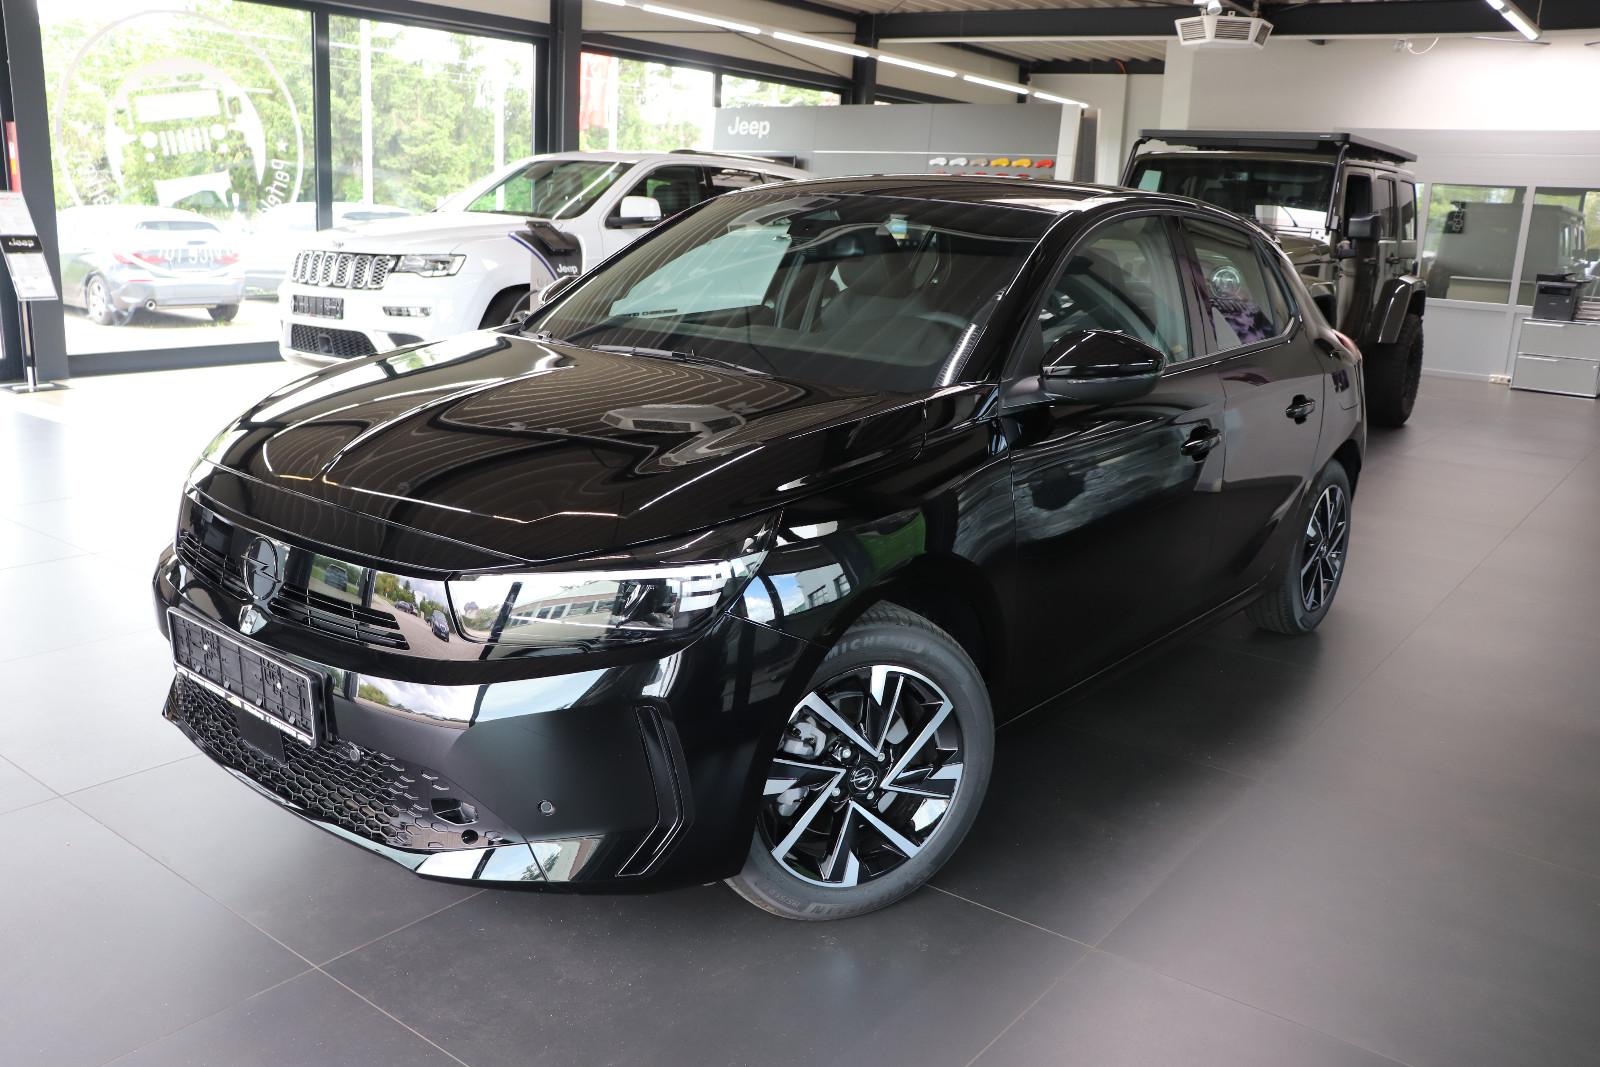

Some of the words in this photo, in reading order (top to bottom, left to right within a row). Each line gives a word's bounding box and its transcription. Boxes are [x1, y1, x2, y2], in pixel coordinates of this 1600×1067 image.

[727, 116, 771, 139] Jeep
[556, 263, 578, 275] Jeep
[824, 635, 925, 661] MICHEN
